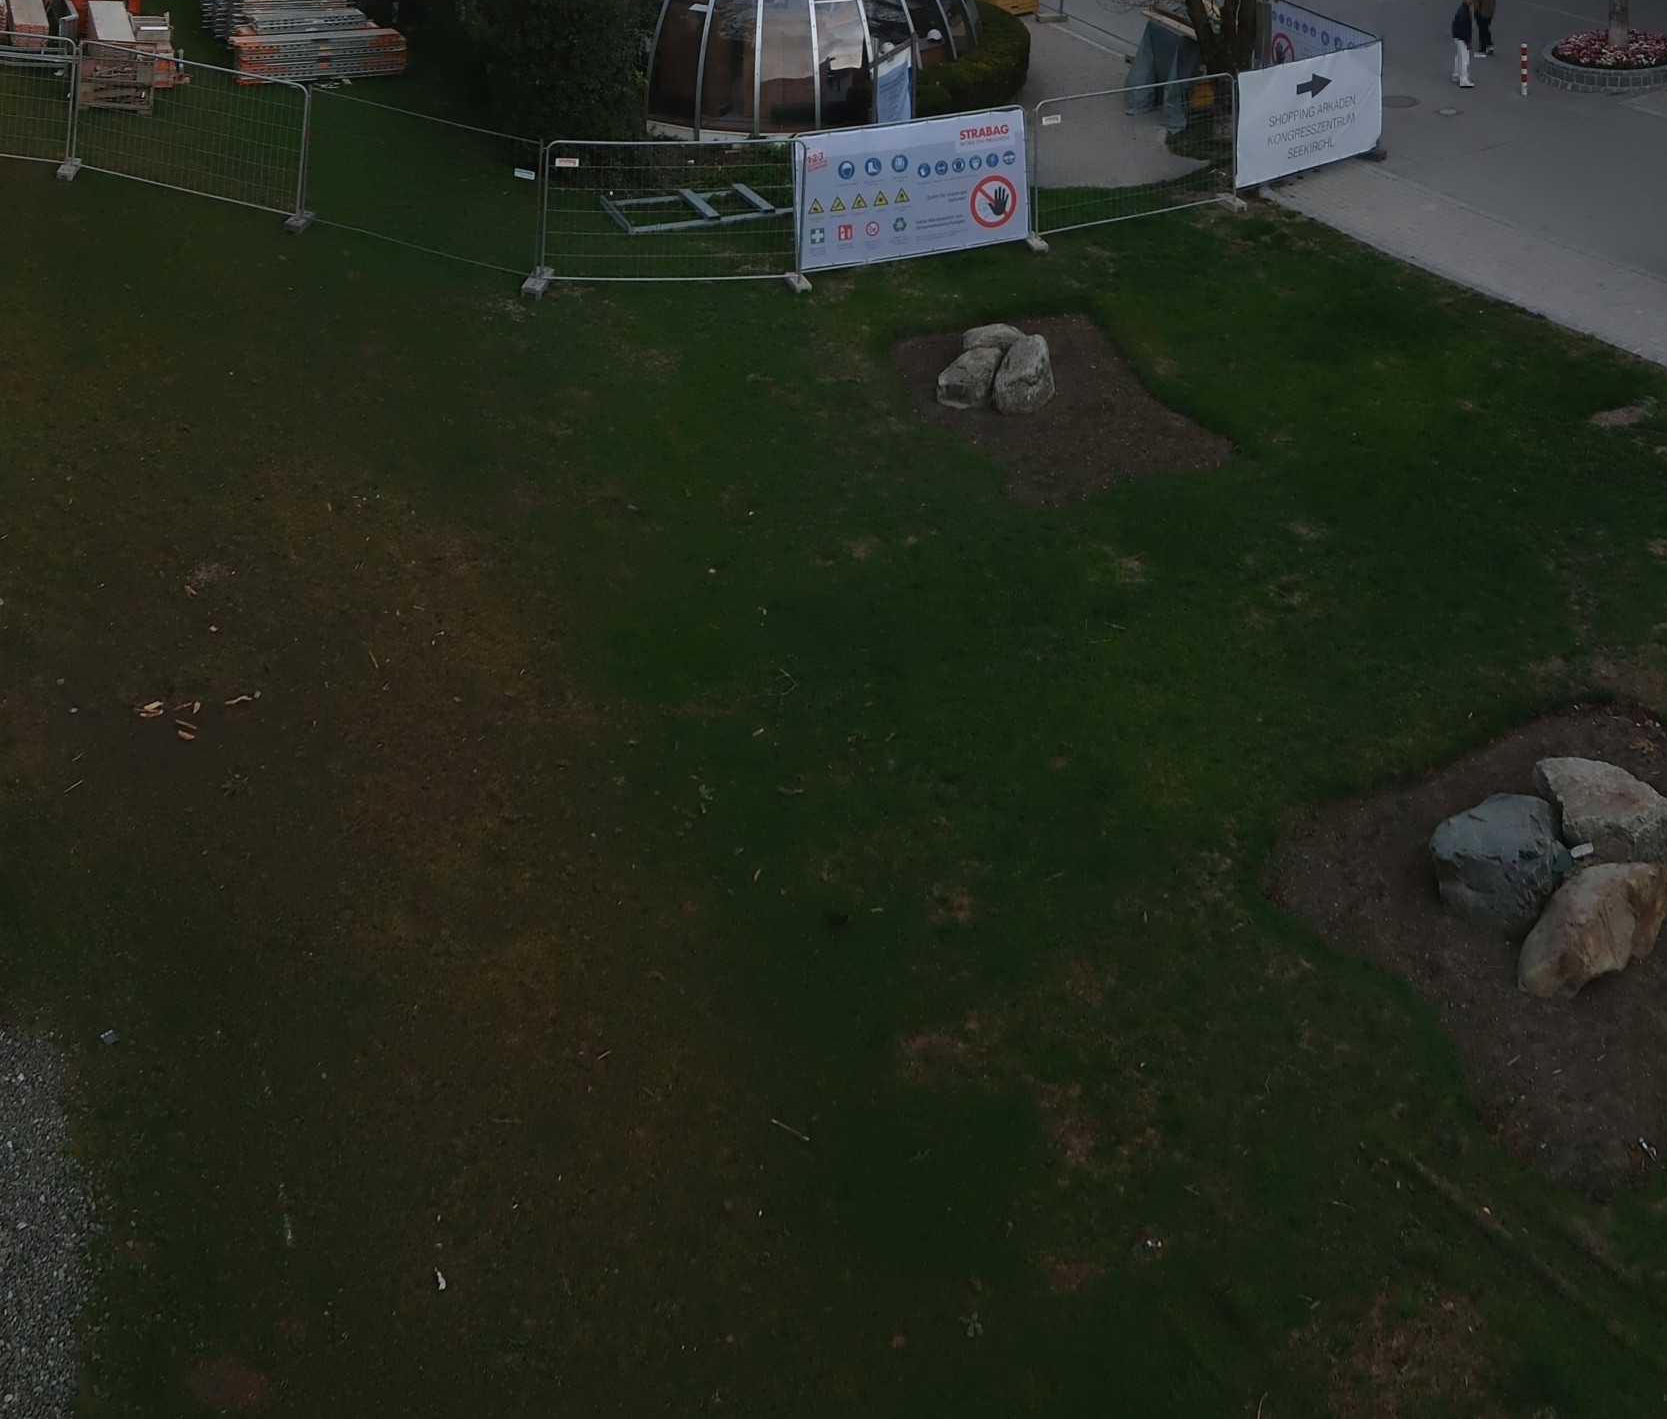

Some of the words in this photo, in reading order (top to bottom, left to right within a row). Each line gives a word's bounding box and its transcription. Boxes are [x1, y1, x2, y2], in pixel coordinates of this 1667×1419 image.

[1268, 105, 1316, 128] SHOPPING
[1317, 94, 1356, 115] ARKADEN
[960, 124, 1009, 141] STRABAG
[1267, 111, 1356, 146] KONGRESSZENTRUM
[1287, 137, 1334, 160] SEEKIRCHL
